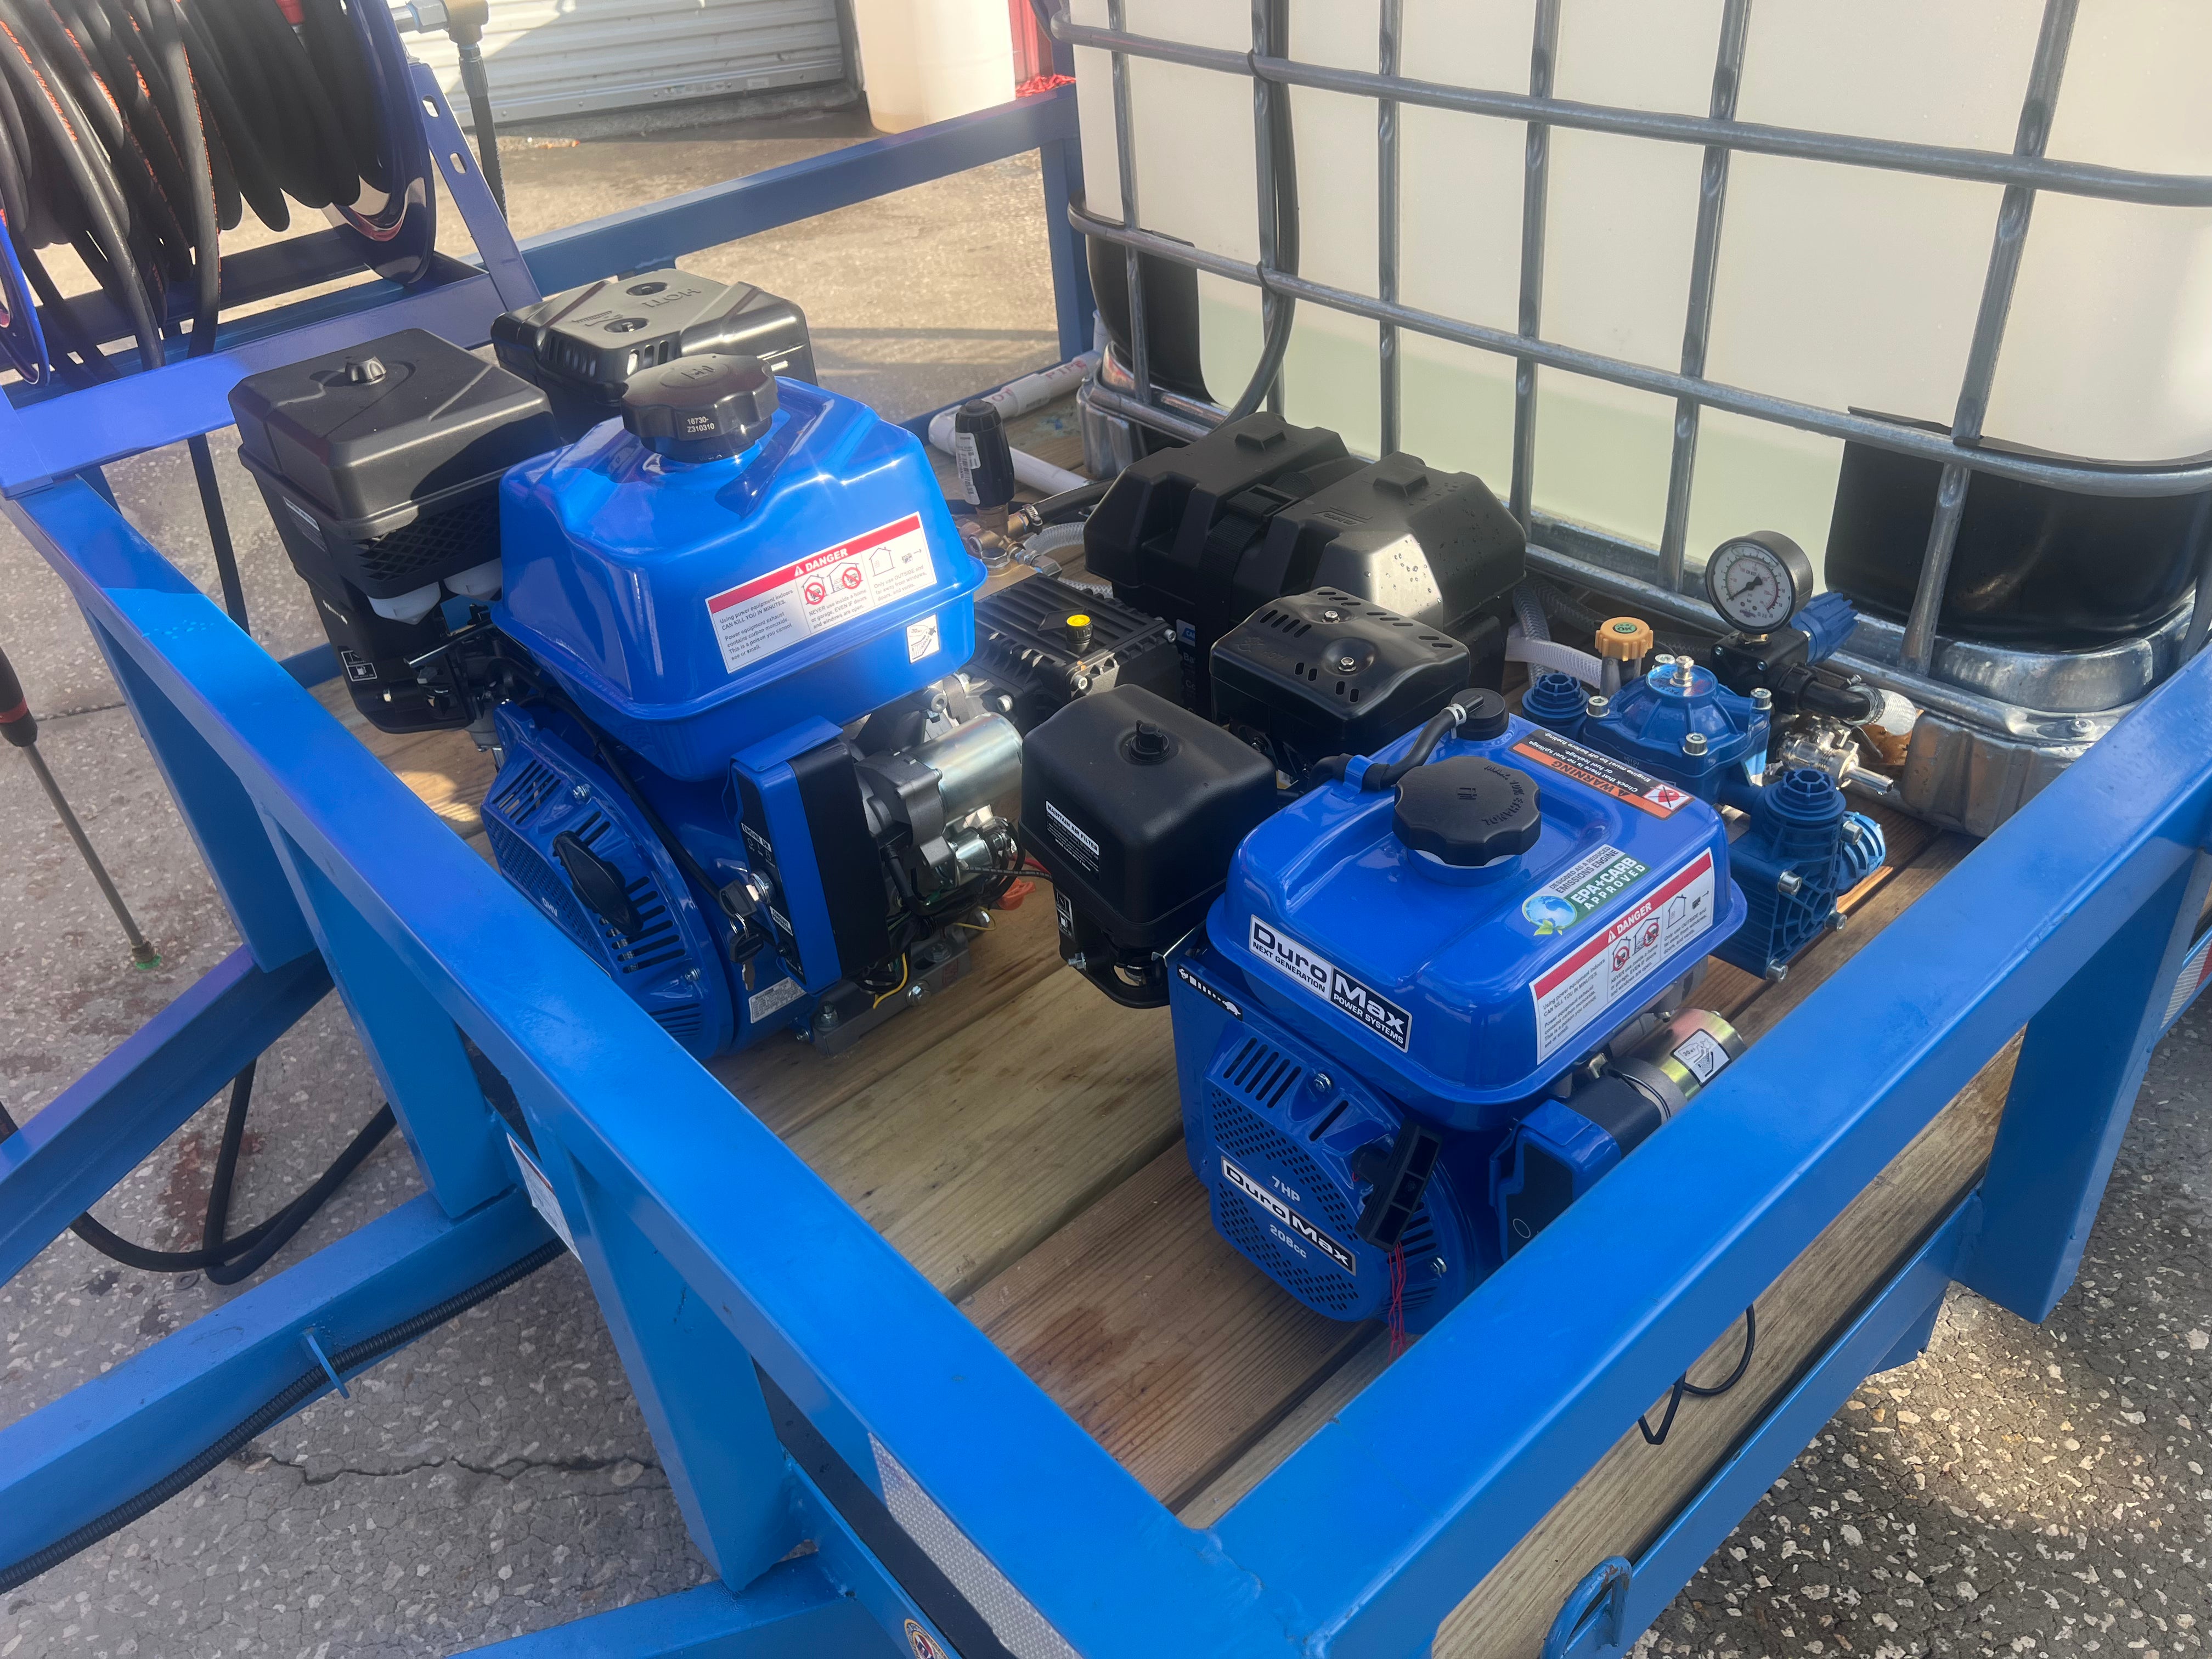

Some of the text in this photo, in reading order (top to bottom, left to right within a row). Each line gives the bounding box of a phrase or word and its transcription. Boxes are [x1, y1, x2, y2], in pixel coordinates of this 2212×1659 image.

[687, 416, 709, 425] 16730-
[687, 422, 715, 433] Z310310
[805, 548, 848, 571] DANGER
[874, 580, 885, 589] Only
[894, 570, 914, 580] OUTSIDE
[720, 590, 793, 624] Using power equipment indoors
[722, 622, 733, 630] CAN
[734, 618, 746, 626] KILL
[763, 600, 786, 613] MINUTES.
[809, 606, 826, 616] NEVER
[835, 595, 850, 605] inside
[854, 589, 867, 597] home
[817, 610, 834, 621] garage,
[835, 603, 848, 612] EVEN
[854, 596, 867, 604] doors
[725, 612, 785, 641] Power equipment exhaust
[823, 613, 843, 626] windows
[851, 605, 865, 614] open.
[727, 618, 789, 647] contains carbon monoxide.
[749, 635, 766, 646] poison
[776, 623, 792, 633] cannot
[747, 645, 761, 653] smell.
[1529, 741, 1554, 754] spillage
[1544, 731, 1568, 747] fueling.
[1569, 741, 1588, 753] before
[1554, 751, 1566, 759] fuel
[1565, 750, 1590, 764] leakage.
[1589, 750, 1599, 759] off
[1591, 760, 1605, 770] fuel
[1611, 761, 1626, 771] must
[1551, 760, 1613, 793] WARNING
[1583, 763, 1599, 774] there
[1599, 771, 1615, 783] that
[1627, 769, 1651, 782] Engine
[1616, 780, 1639, 792] Check
[1047, 805, 1098, 850] MAINTAIN AIR FILTER
[1549, 870, 1576, 889] DESIGNED
[1586, 846, 1611, 864] REDUCED
[1556, 849, 1618, 894] EMISSIONS ENGINE
[1570, 857, 1638, 904] EPA+CARB
[1583, 865, 1645, 910] APPROVED
[1617, 902, 1652, 934] DANGER
[1664, 933, 1673, 942] Only
[1681, 913, 1699, 928] OUTSIDE
[1669, 935, 1679, 946] away
[1680, 927, 1689, 936] from
[1611, 969, 1625, 984] NEVER
[1632, 955, 1644, 967] inside
[1647, 944, 1658, 955] home
[1630, 964, 1641, 975] EVEN
[1645, 951, 1657, 961] doors
[1253, 941, 1403, 1044] NEXT GENERATION POWER SYSTEMS
[1543, 959, 1605, 1010] Using power equipment indoors
[1618, 976, 1635, 990] windows
[1544, 1006, 1554, 1017] CAN
[1554, 1000, 1563, 1010] KILL
[1564, 991, 1573, 1001] YOU
[1545, 985, 1594, 1028] Power equipment exhaust
[1545, 1032, 1554, 1041] This
[1561, 1014, 1575, 1029] poison
[1575, 1008, 1583, 1017] you
[1583, 996, 1596, 1009] cannot
[1545, 1019, 1561, 1035] contains
[1562, 1007, 1575, 1020] carbon
[1272, 1176, 1300, 1201] 7HP
[1269, 1224, 1307, 1259] 208cc
